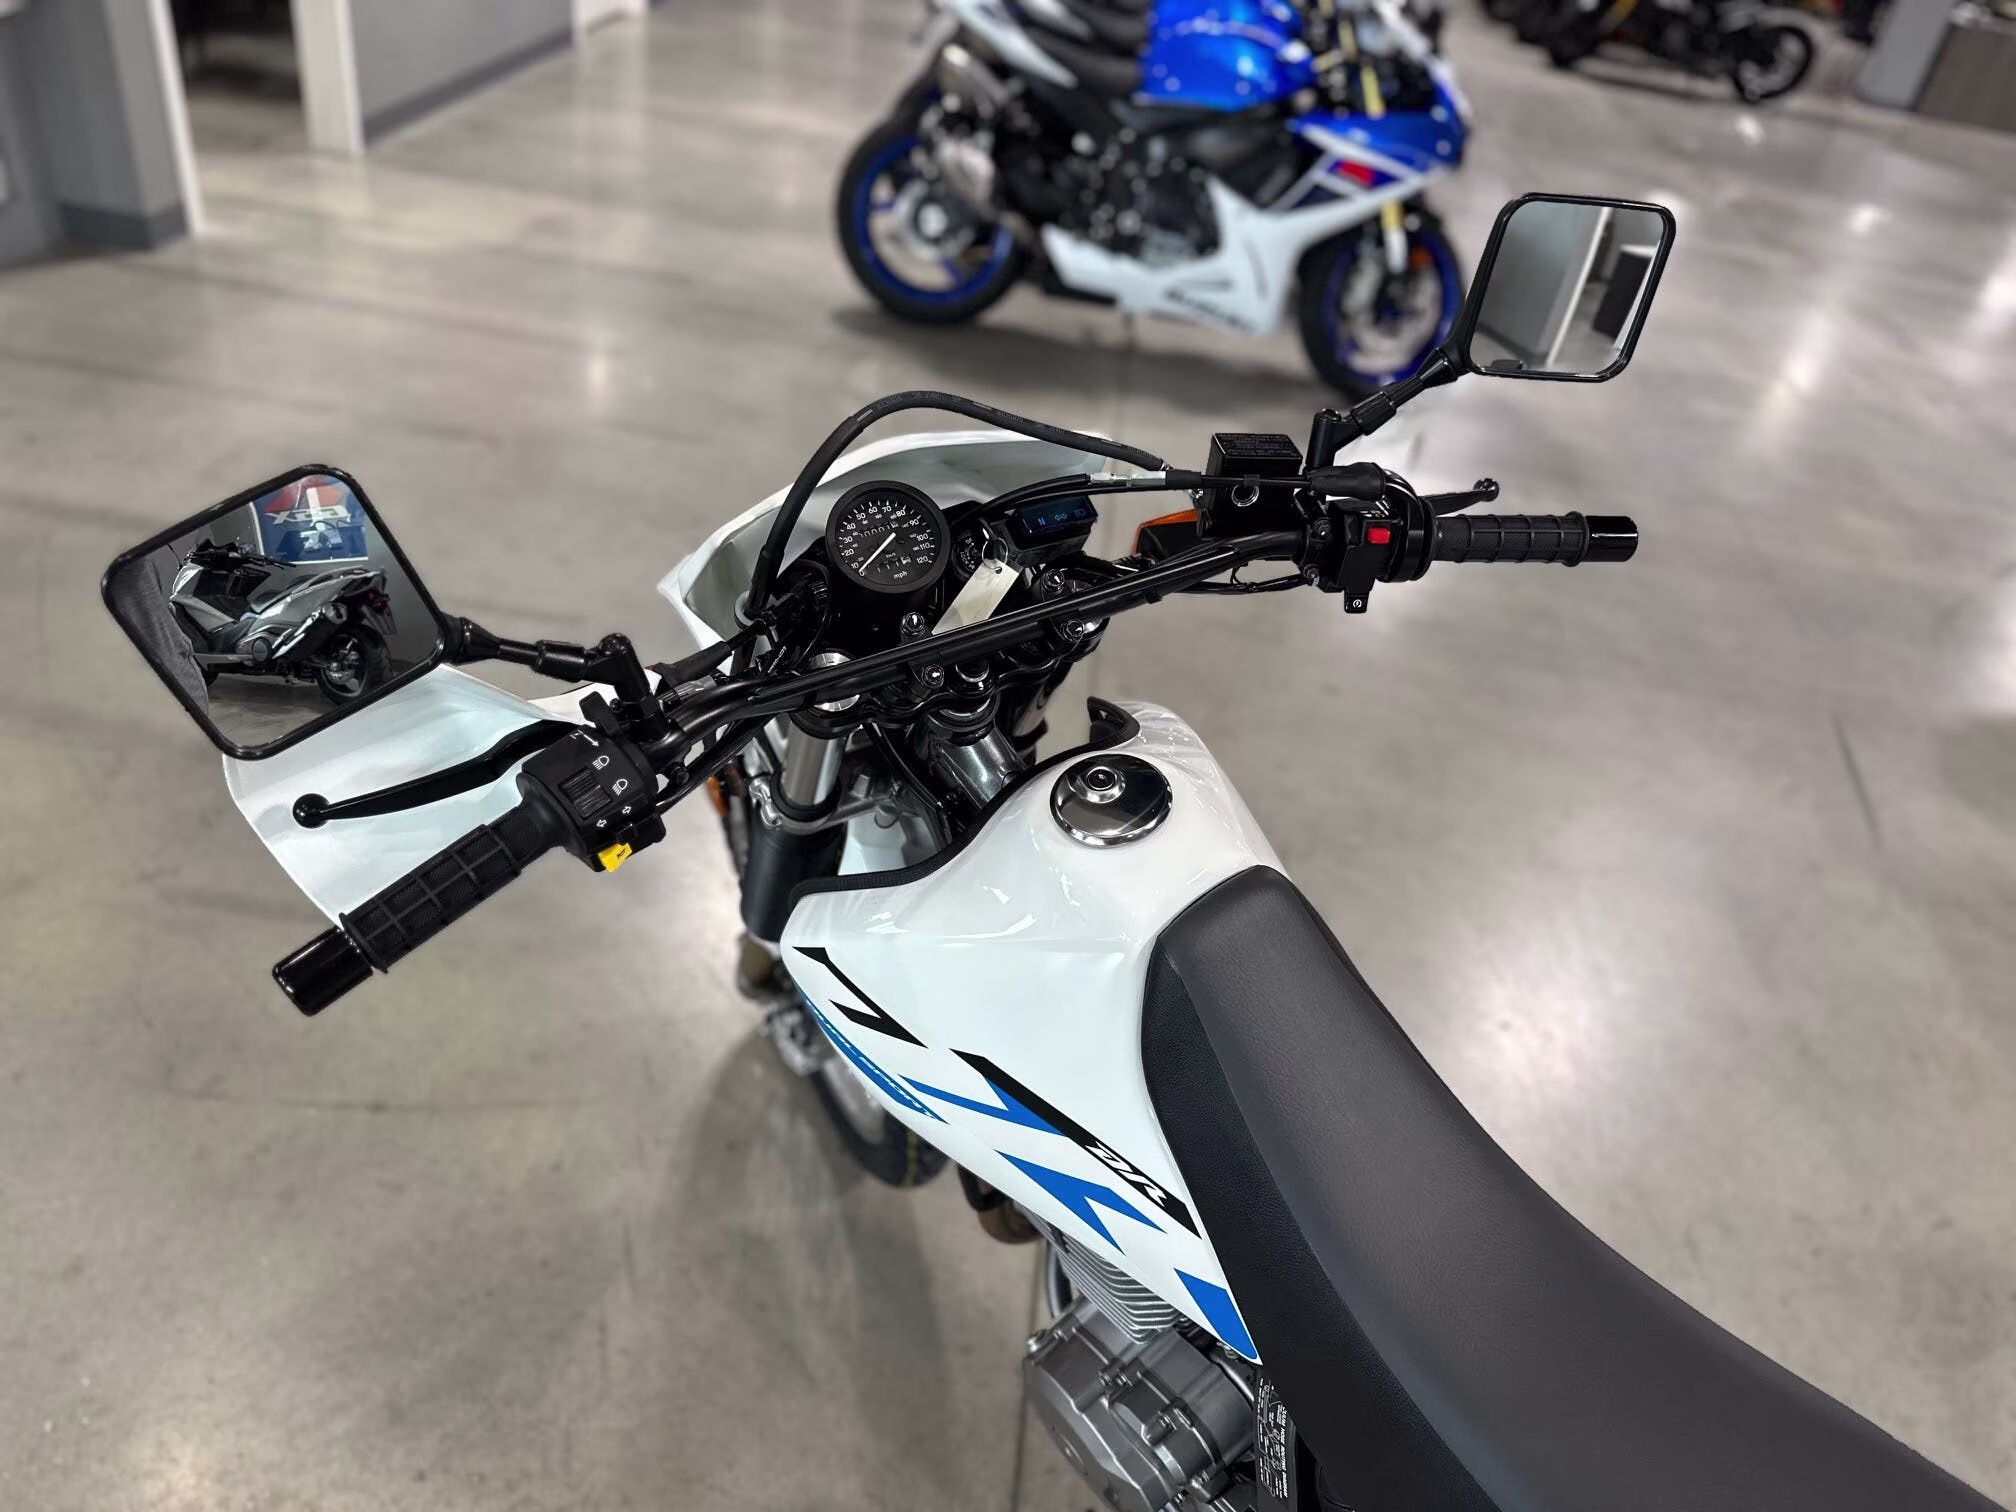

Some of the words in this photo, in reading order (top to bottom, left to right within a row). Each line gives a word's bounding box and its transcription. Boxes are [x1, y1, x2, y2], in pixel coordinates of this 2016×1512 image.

[868, 506, 878, 514] 60
[881, 505, 892, 513] 70
[896, 509, 906, 517] 80
[856, 512, 866, 520] 50
[846, 522, 856, 530] 40
[909, 518, 920, 526] 90
[843, 536, 853, 544] 30
[916, 533, 929, 541] 100
[919, 542, 931, 550] 110
[843, 548, 855, 556] 20
[916, 556, 929, 564] 120
[893, 570, 908, 580] mph
